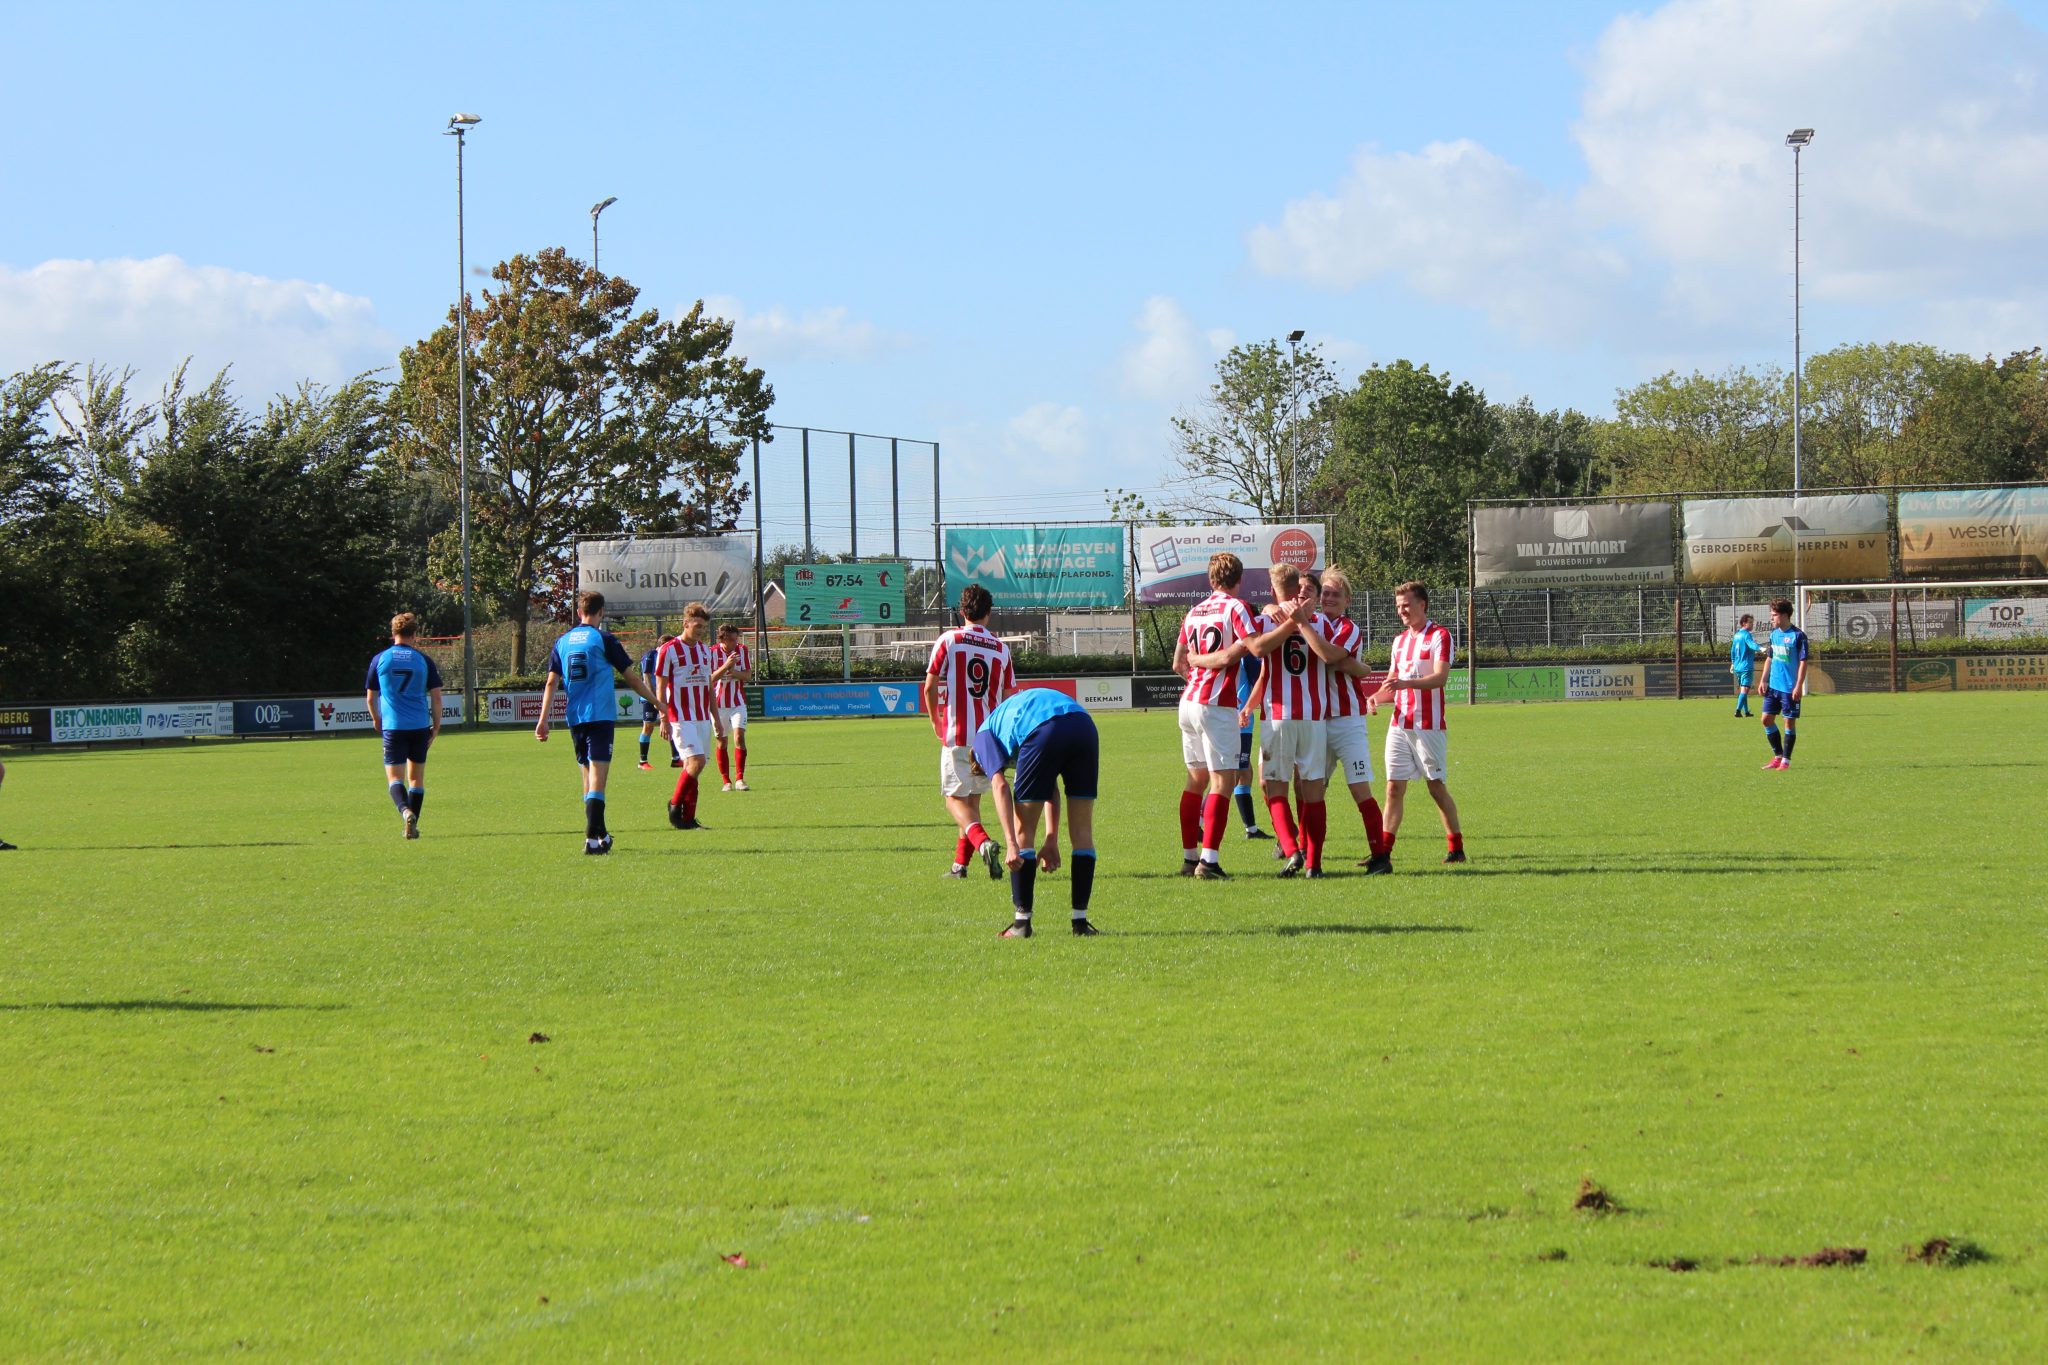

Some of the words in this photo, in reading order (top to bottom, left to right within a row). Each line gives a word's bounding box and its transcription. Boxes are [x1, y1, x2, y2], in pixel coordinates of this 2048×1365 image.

[1175, 537, 1201, 545] van
[1207, 535, 1225, 544] de
[1231, 533, 1255, 544] Pol
[1013, 542, 1116, 556] VERHOEVEN
[1178, 546, 1258, 554] schilderwerken
[1516, 543, 1544, 557] VAN
[1547, 540, 1627, 556] ZANTVOORT
[1692, 543, 1767, 554] GEBROEDERS
[1797, 540, 1849, 551] HERPEN
[1014, 557, 1096, 570] MONTAGE
[1536, 558, 1594, 567] BOUWBEDRIJF
[1597, 557, 1608, 565] BV
[585, 568, 624, 583] Mike
[826, 575, 863, 587] 67:54
[1014, 571, 1058, 579] WANDEN.
[1061, 570, 1114, 578] PLAFONDS.
[1485, 571, 1664, 586] www.vanzantvoortbouwbedrijf.nl
[800, 604, 811, 621] 2
[880, 602, 891, 619] 0
[1989, 606, 2025, 621] TOP
[1988, 621, 2022, 629] MOVERS
[1189, 626, 1222, 655] 12
[1283, 634, 1307, 676] 6
[1966, 658, 2046, 667] BEMIDDEL
[967, 657, 989, 699] 9
[1969, 668, 1987, 677] EN
[1997, 667, 2045, 676] TAXAT
[391, 668, 414, 695] 7
[1445, 683, 1488, 691] LEIDINEN
[1569, 675, 1634, 688] HEIJDEN
[54, 707, 142, 728] BETONBORINGEN
[55, 727, 114, 741] GEFFEN
[117, 726, 143, 737] B.V.
[1353, 760, 1365, 770] 15
